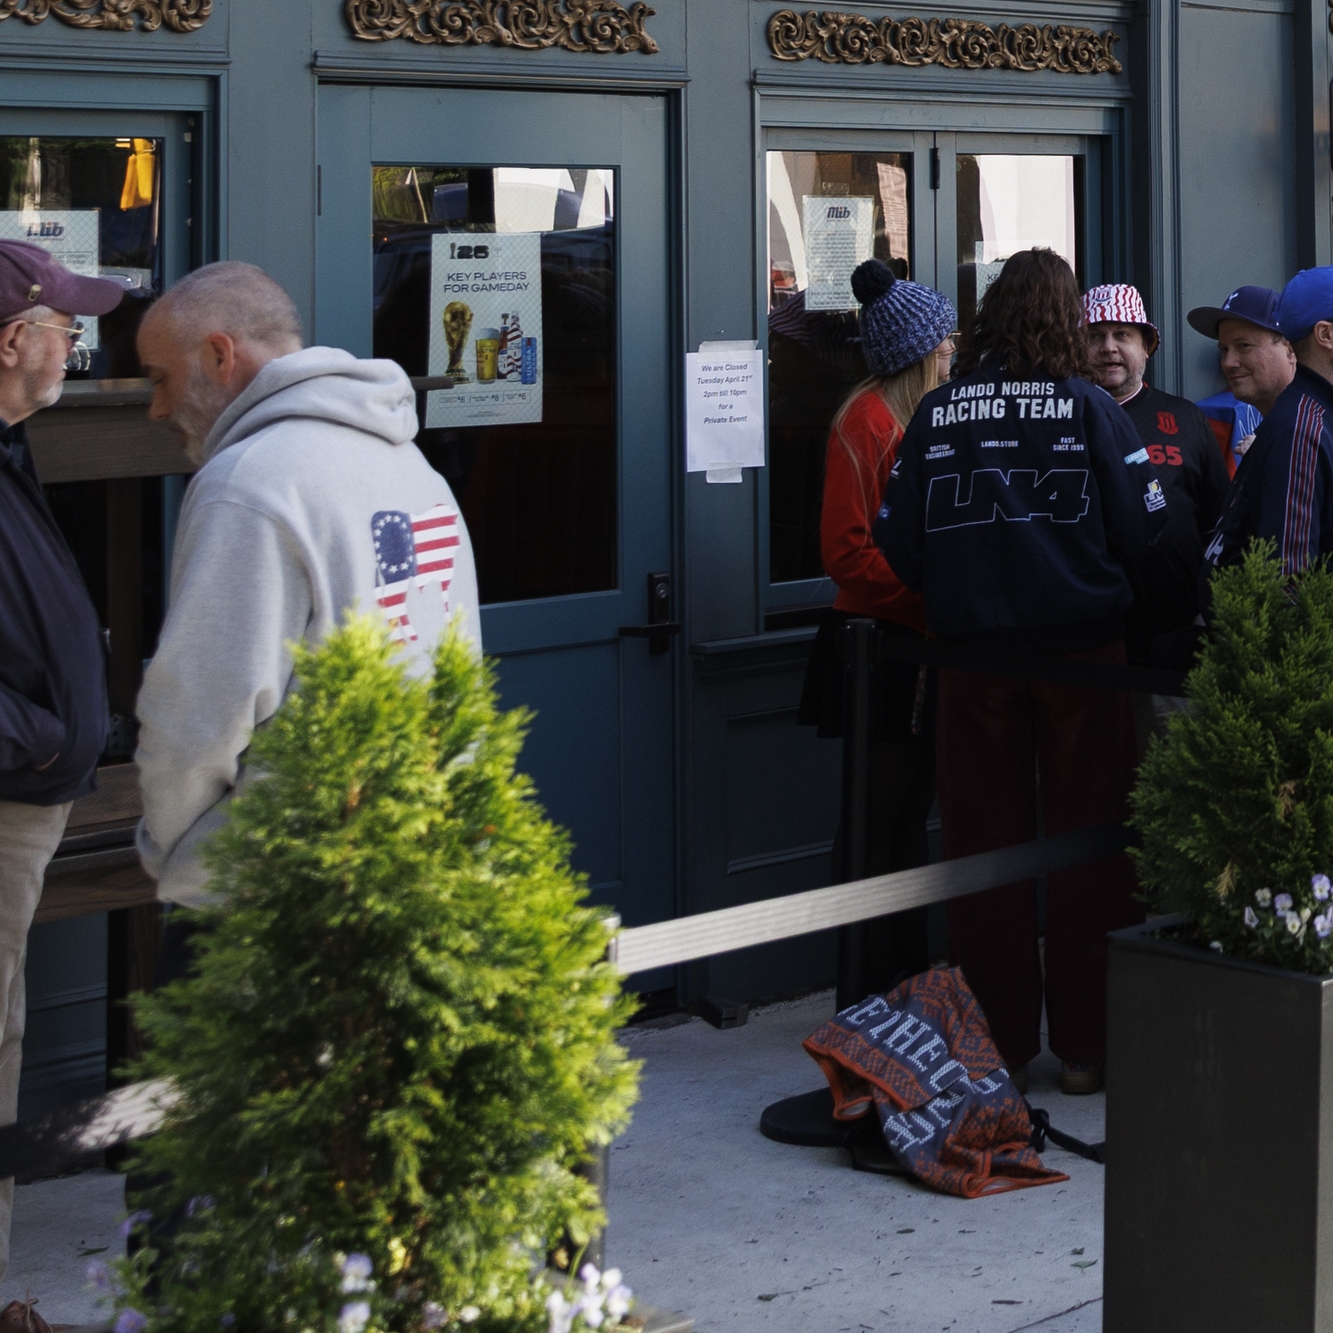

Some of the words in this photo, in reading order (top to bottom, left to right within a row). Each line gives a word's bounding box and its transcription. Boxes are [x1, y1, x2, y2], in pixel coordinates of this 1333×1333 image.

[447, 272, 472, 281] KEY
[474, 271, 527, 281] PLAYERS
[444, 284, 469, 293] FOR
[471, 282, 530, 292] GAMEDAY
[725, 363, 748, 371] Closed
[725, 376, 740, 384] April
[730, 389, 747, 397] 10pm
[951, 383, 995, 401] LANDO
[1001, 381, 1055, 396] NORRIS
[932, 398, 1006, 427] RACING
[1016, 398, 1074, 419] TEAM
[929, 444, 950, 453] BRITISH
[981, 440, 1019, 448] LANDO.STORE
